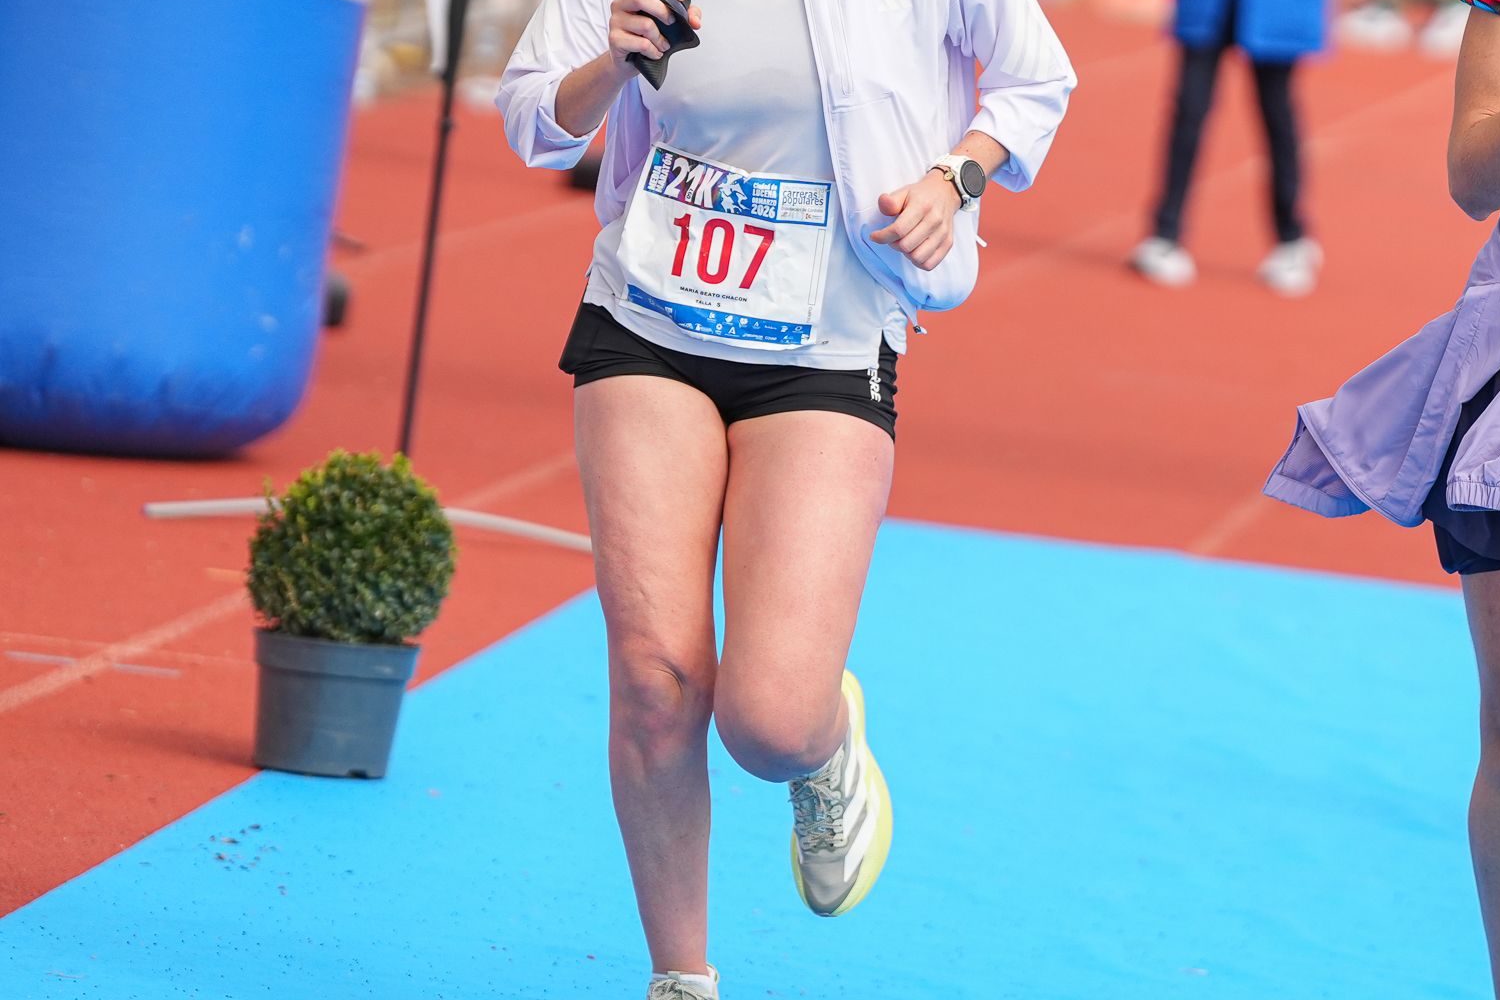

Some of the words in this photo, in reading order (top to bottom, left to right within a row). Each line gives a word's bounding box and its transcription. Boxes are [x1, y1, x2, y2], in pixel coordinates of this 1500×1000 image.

[647, 165, 662, 190] MEDIA
[655, 152, 673, 193] MARATÓN
[664, 157, 723, 208] 21K
[782, 196, 824, 206] populares
[783, 189, 818, 199] carreras
[750, 203, 776, 219] 2026
[671, 213, 775, 289] 107
[680, 286, 699, 294] MARIA
[721, 294, 748, 302] CHACON
